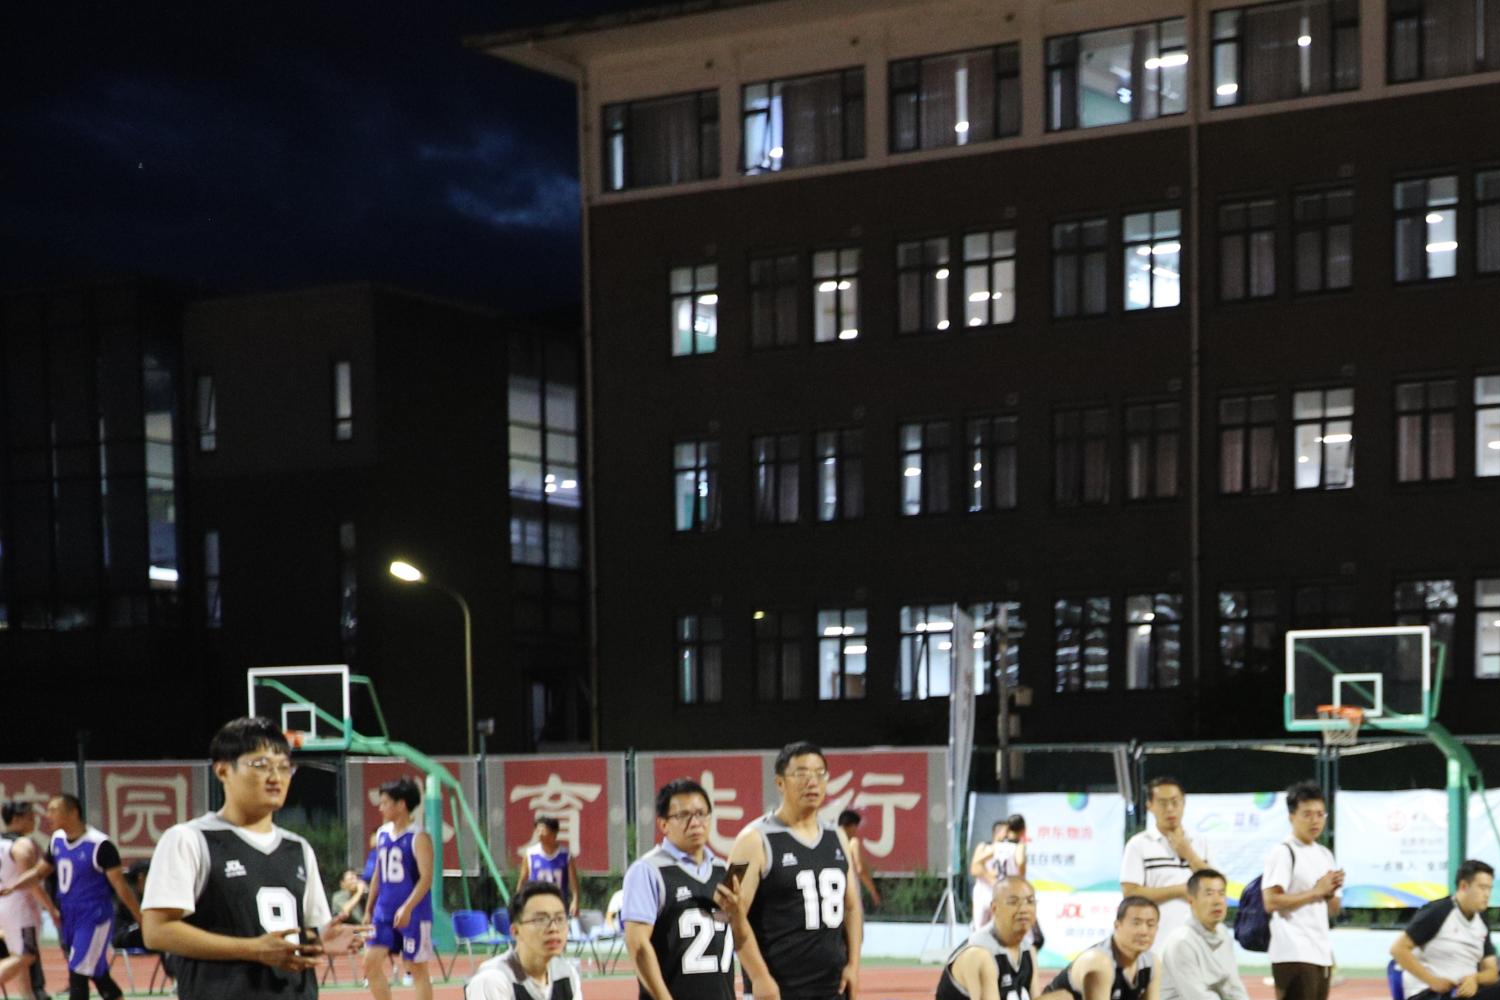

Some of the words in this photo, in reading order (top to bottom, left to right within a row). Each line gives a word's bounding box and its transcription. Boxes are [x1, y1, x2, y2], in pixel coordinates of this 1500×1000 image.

[106, 772, 188, 857] 园
[510, 773, 602, 857] 育
[818, 769, 921, 858] 行
[796, 868, 846, 930] 18
